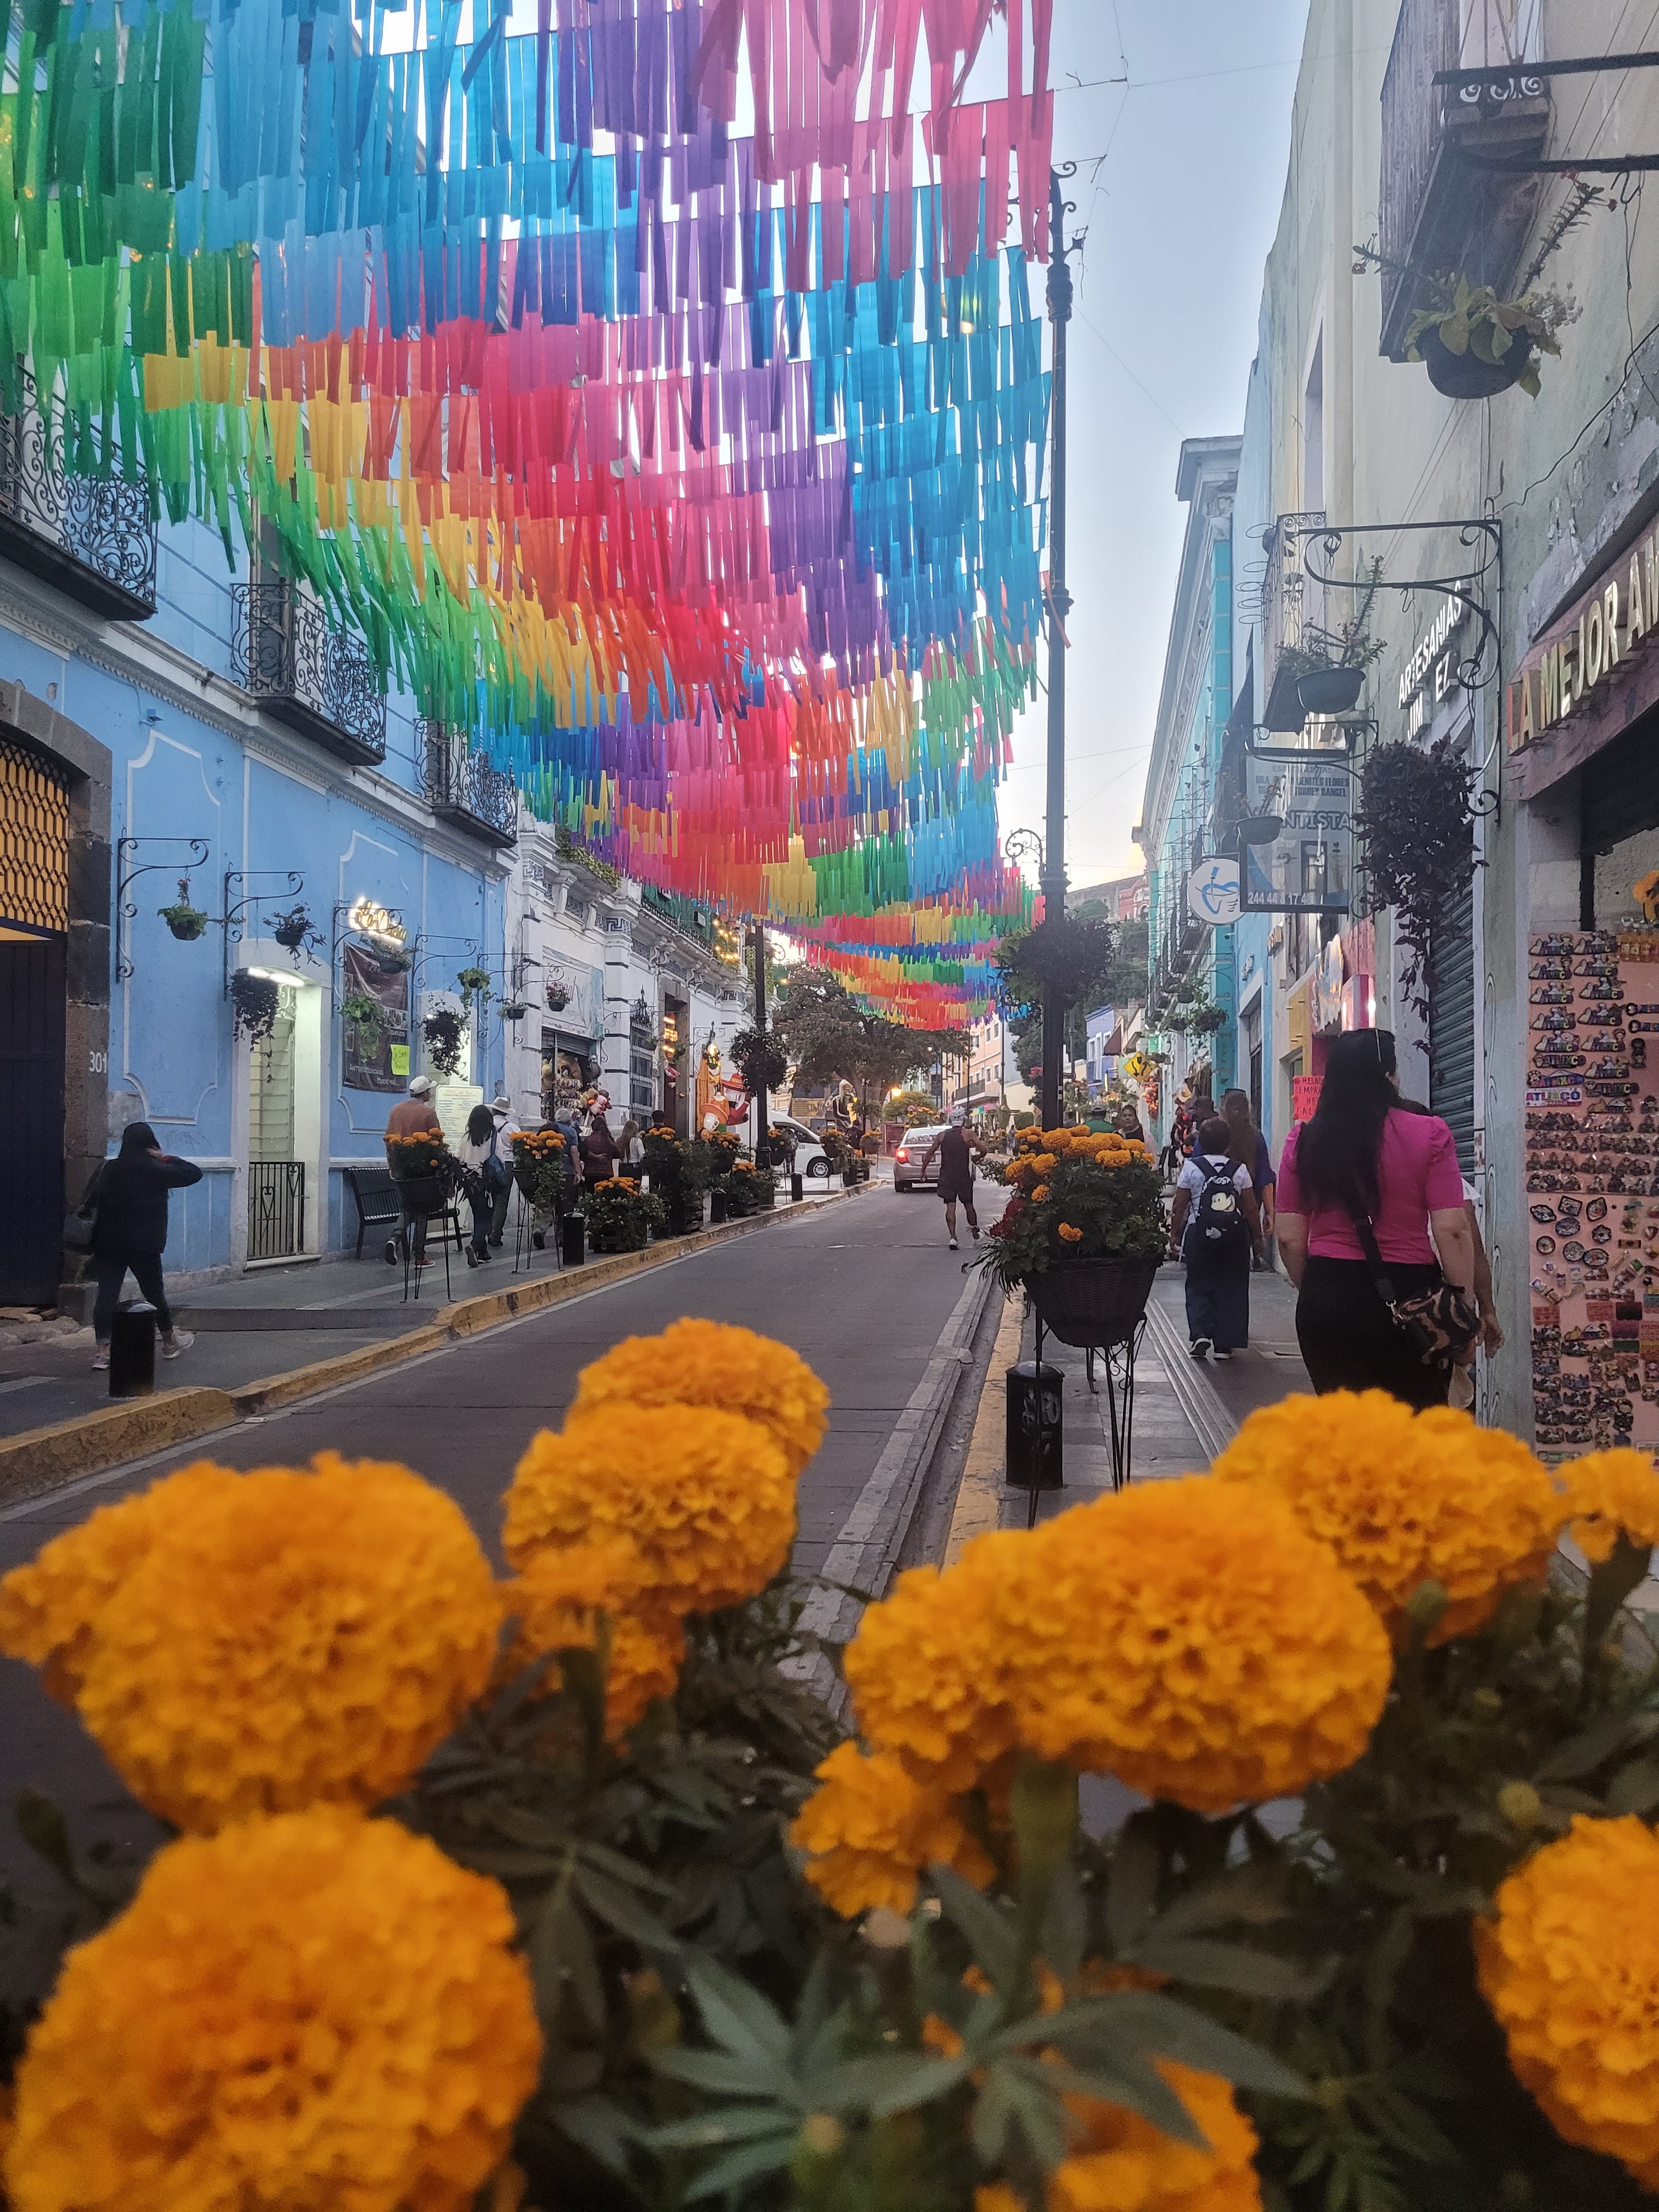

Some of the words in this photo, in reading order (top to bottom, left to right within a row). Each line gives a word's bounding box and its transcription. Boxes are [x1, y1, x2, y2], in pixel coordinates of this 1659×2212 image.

[1398, 580, 1462, 710] ARTESANIAS
[1507, 669, 1535, 756] LA
[1541, 580, 1619, 730] MEJOR
[1248, 891, 1265, 904] 244
[1267, 892, 1278, 904] 44
